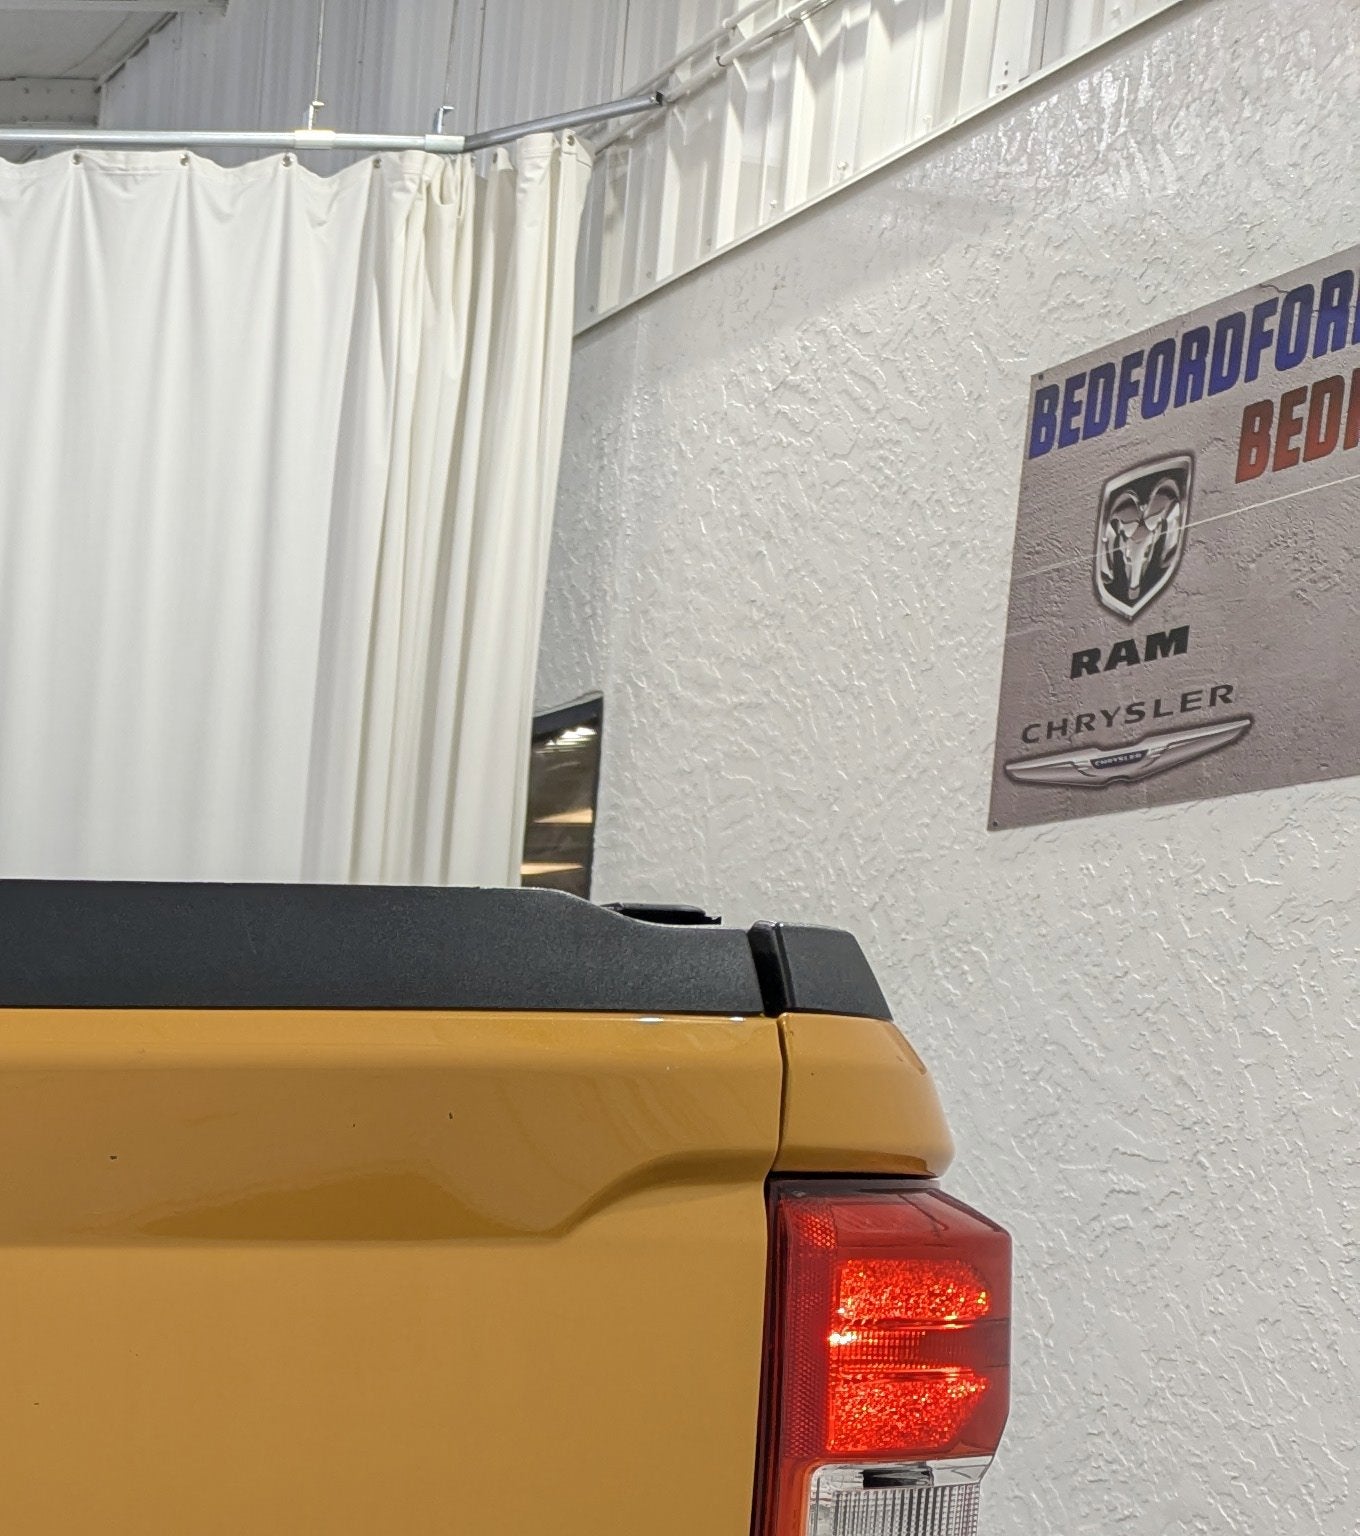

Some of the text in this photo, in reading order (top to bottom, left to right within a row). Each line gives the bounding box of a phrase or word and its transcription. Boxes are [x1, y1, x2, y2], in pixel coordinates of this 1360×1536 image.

[1028, 268, 1360, 461] BEDFORDFOR
[1070, 625, 1191, 680] RAM
[1021, 684, 1235, 743] CHRYSLER
